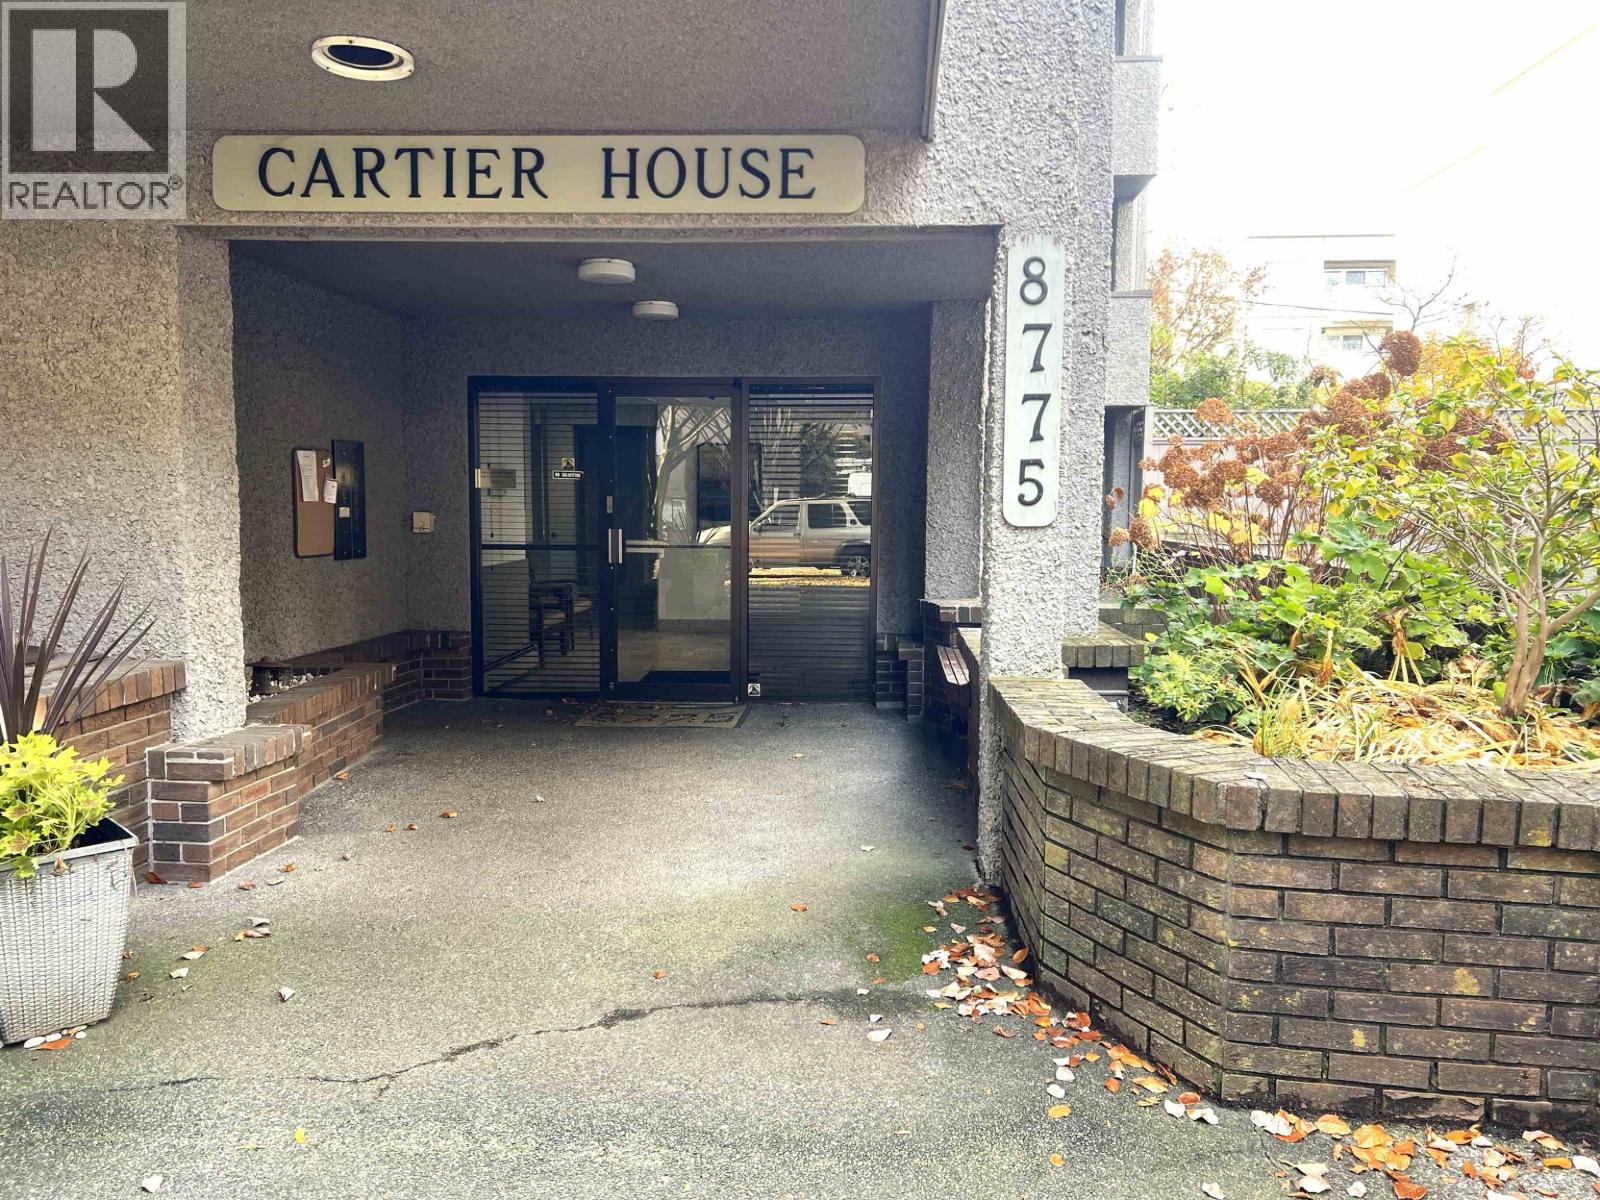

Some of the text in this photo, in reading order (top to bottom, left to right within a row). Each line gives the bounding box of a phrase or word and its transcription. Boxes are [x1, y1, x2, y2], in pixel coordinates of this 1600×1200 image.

[258, 146, 816, 199] CARTIER HOUSE
[1019, 256, 1053, 507] 8775
